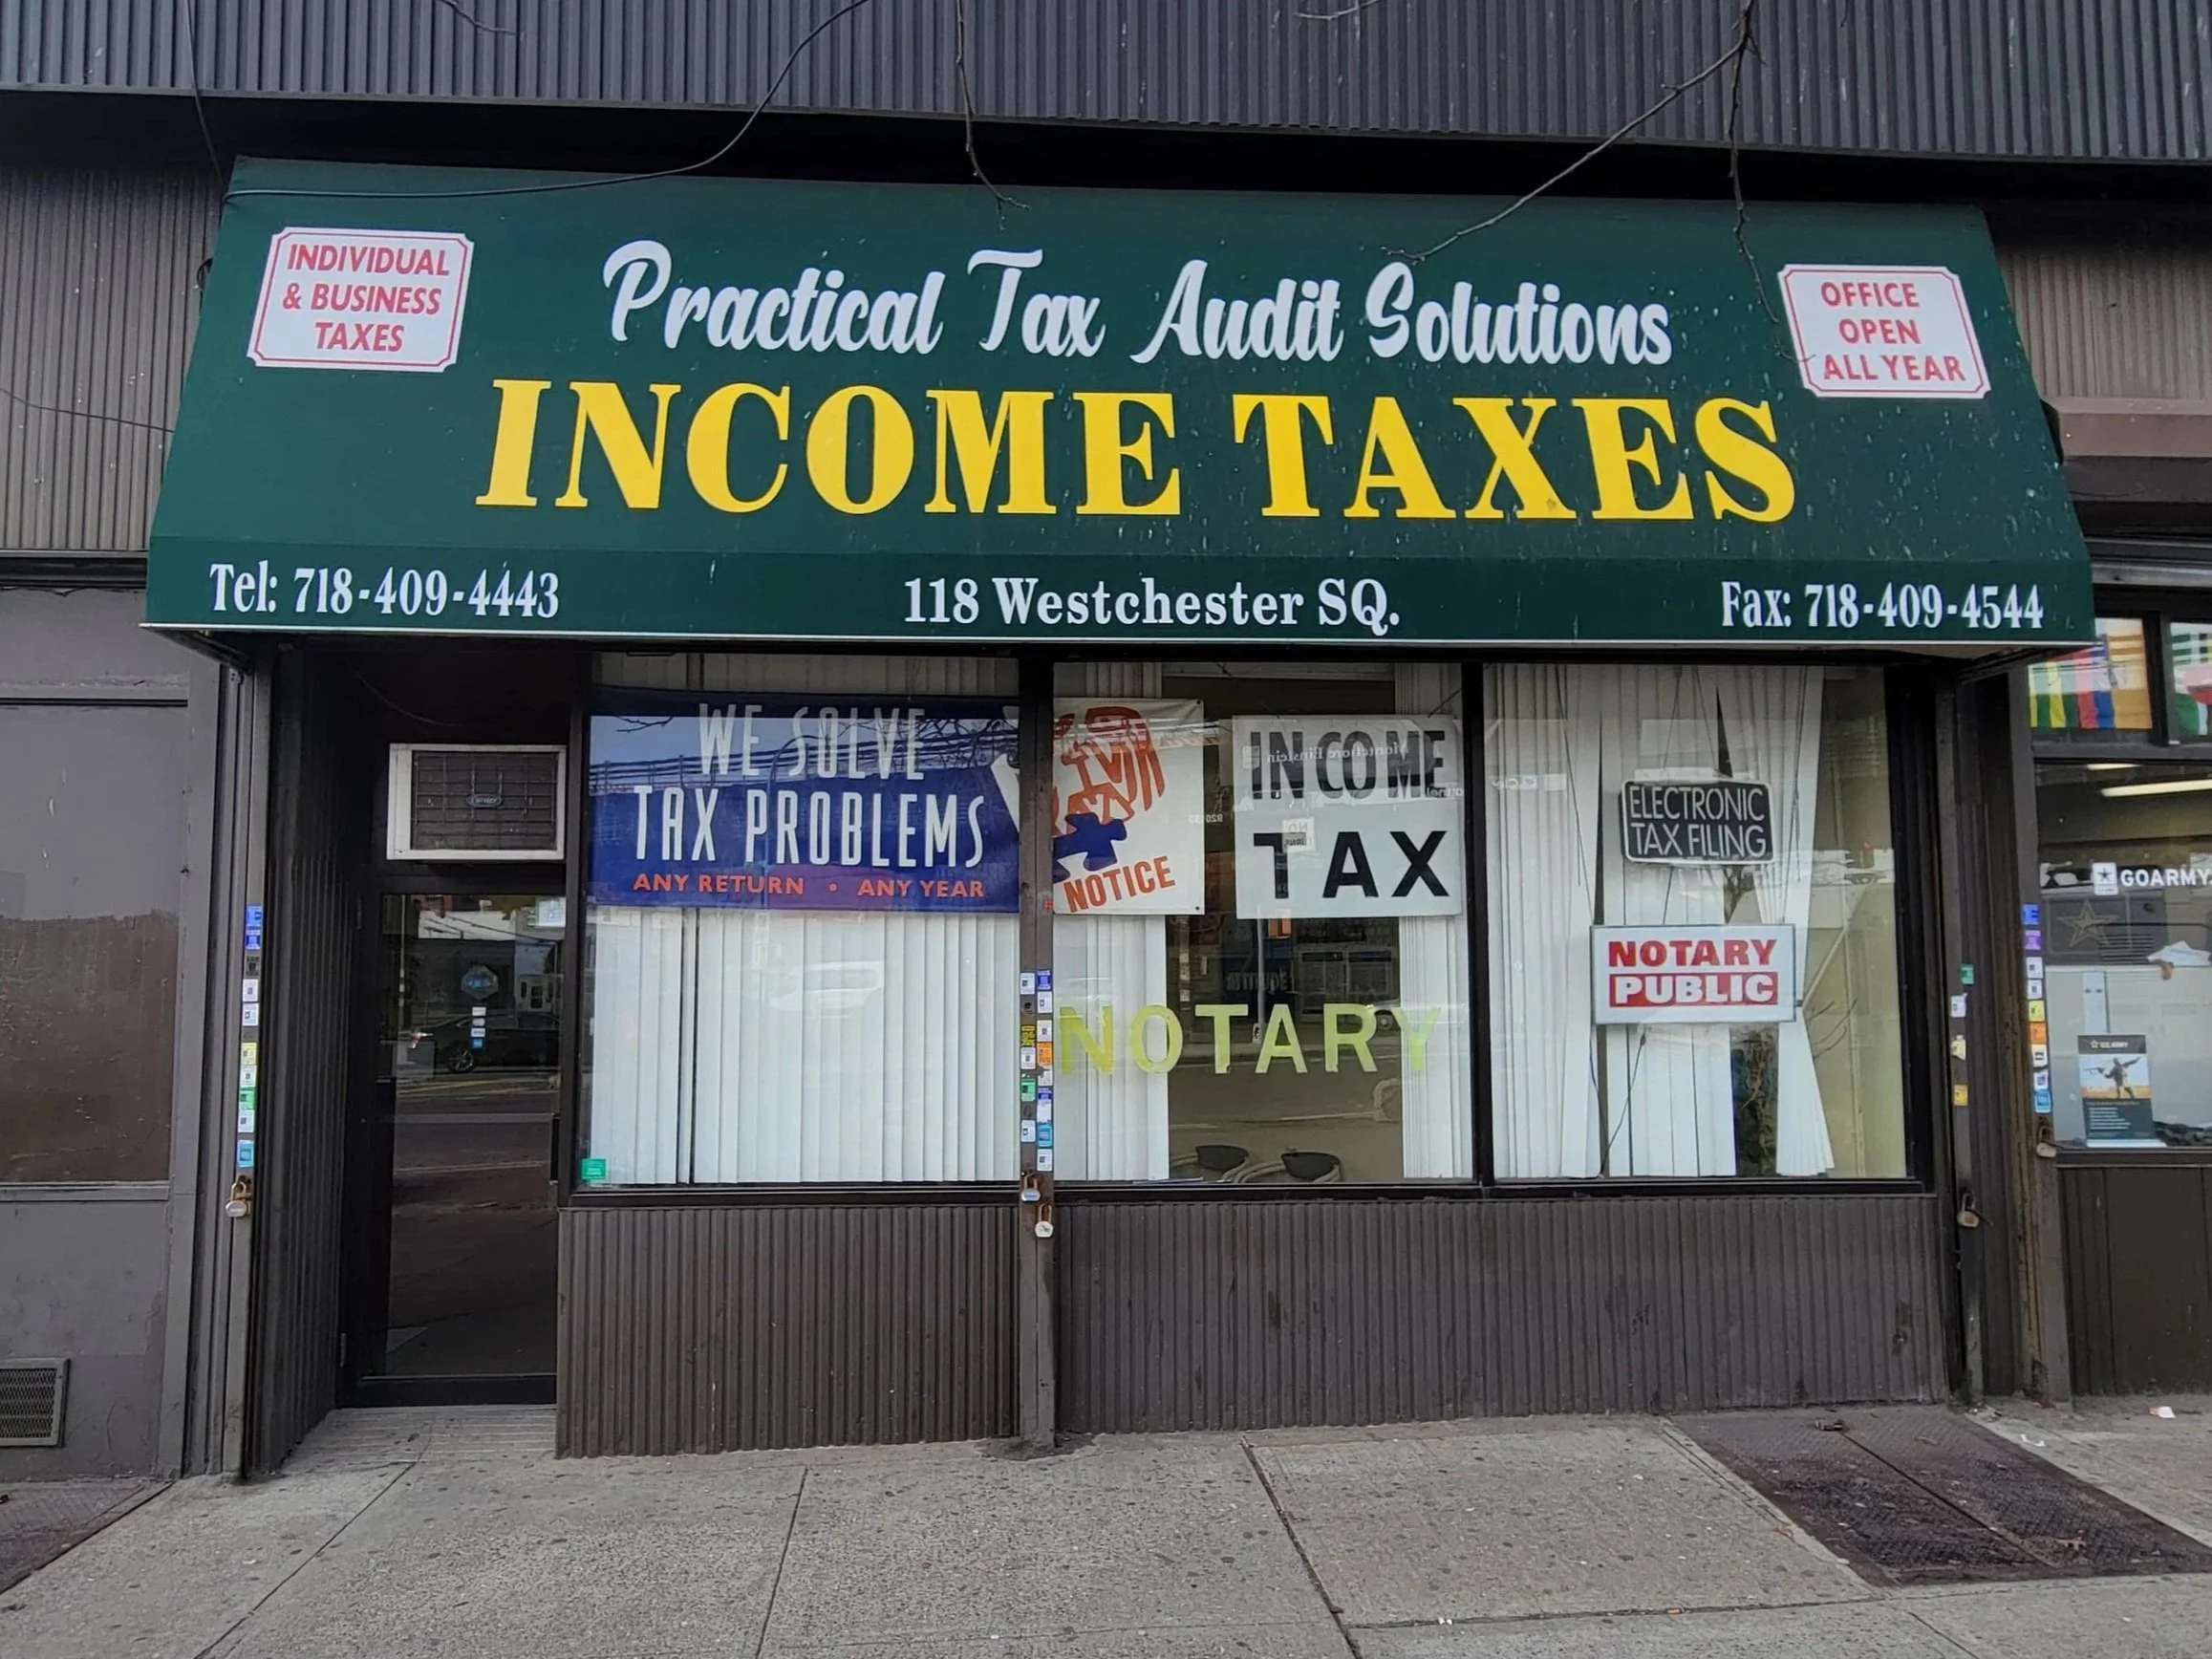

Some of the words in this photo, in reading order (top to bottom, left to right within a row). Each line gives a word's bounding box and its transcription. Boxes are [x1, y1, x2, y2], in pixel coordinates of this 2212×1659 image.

[286, 243, 450, 276] INDIVIDUAL
[283, 283, 302, 312] &
[311, 283, 442, 315] BUSINESS
[602, 239, 946, 355] Practical
[967, 248, 1106, 357] Tax
[1129, 259, 1345, 363] Audit
[1364, 261, 1672, 365] Solutions
[1820, 281, 1921, 309] OFFICE
[315, 322, 404, 354] TAXES
[1838, 318, 1922, 345] OPEN
[1822, 354, 1879, 382] ALL
[1883, 355, 1966, 382] YEAR
[475, 377, 1181, 516] INCOME
[1232, 393, 1795, 524] TAXES
[209, 559, 278, 614] Tel:
[293, 567, 560, 618] 718-409-4443
[904, 577, 979, 625] 118
[992, 577, 1304, 627] Westchester
[1318, 578, 1401, 637] SQ.
[1721, 580, 1792, 628] Fax:
[1805, 583, 2044, 630] 718-409-4544
[698, 703, 762, 777] WE
[787, 705, 926, 781] SOLVE
[1250, 729, 1446, 800] INCOME
[1628, 785, 1766, 822] ELECTRONIC
[634, 785, 719, 861] TAX
[745, 789, 985, 868] PROBLEMS
[1630, 822, 1683, 856] TAX
[1686, 823, 1767, 858] FILING
[633, 873, 687, 892] ANY
[698, 874, 804, 894] RETURN
[857, 878, 913, 897] ANY
[919, 880, 985, 898] YEAR
[1063, 854, 1175, 913] NOTICE
[1253, 830, 1450, 900] TAX
[1607, 938, 1777, 968] NOTARY
[1614, 974, 1774, 1003] PUBLIC
[1058, 1002, 1444, 1075] NOTARY
